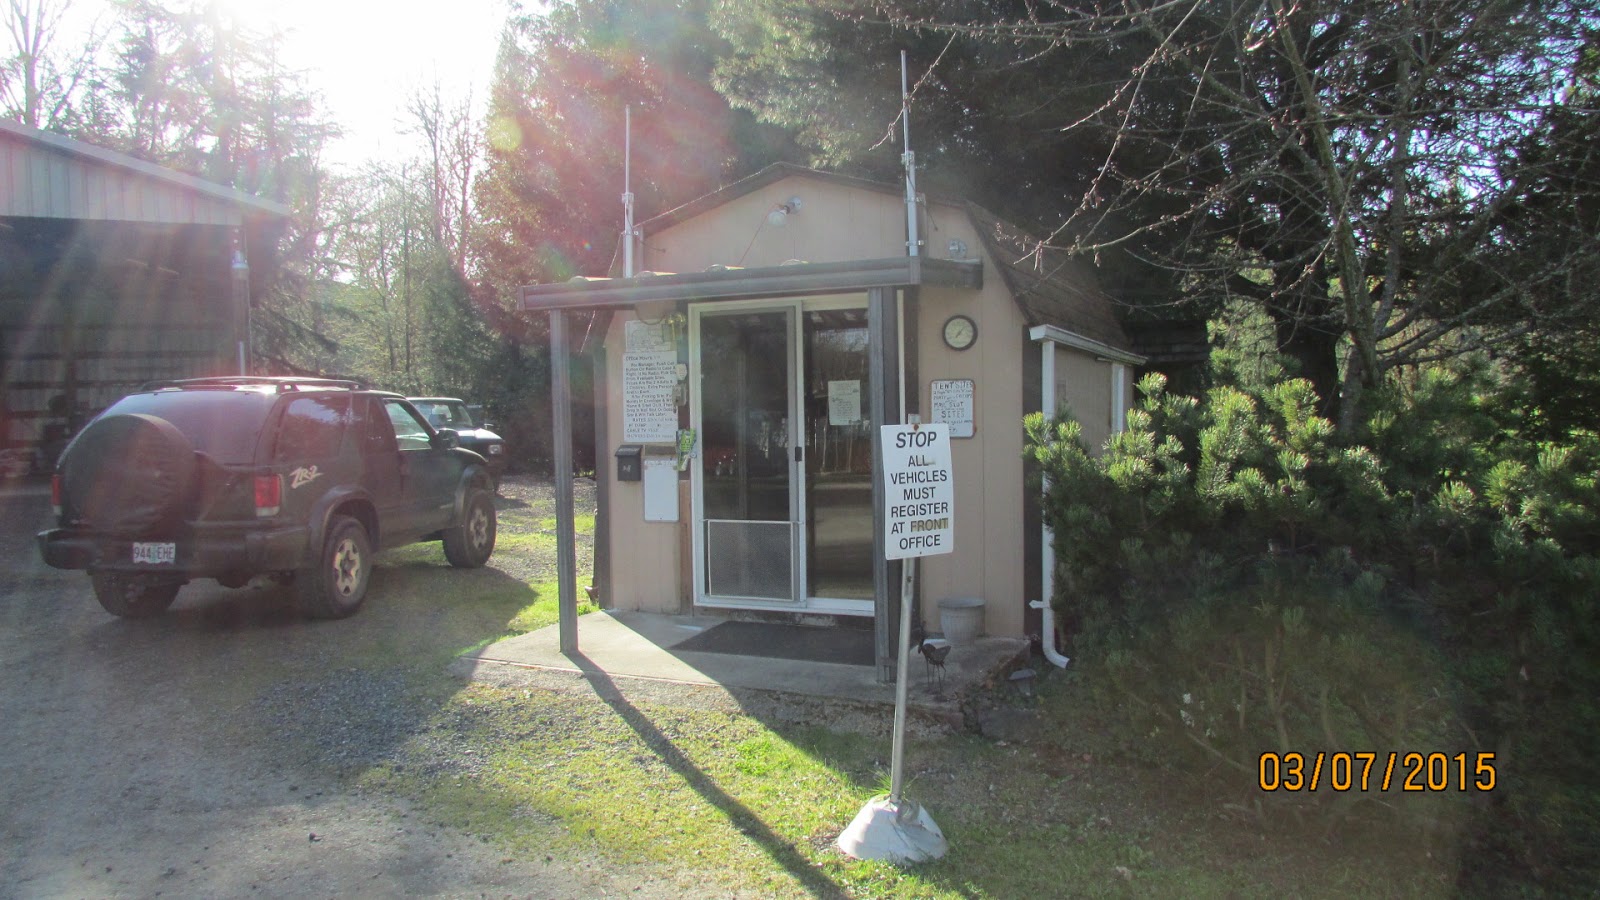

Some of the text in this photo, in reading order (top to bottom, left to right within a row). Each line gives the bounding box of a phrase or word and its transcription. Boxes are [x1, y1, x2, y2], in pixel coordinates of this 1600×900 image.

[896, 431, 937, 448] STOP
[908, 455, 929, 467] ALL
[890, 469, 947, 485] VEHICLES
[904, 486, 936, 501] MUST
[891, 502, 948, 518] REGISTER
[891, 518, 948, 534] AT FRONT
[899, 534, 941, 550] OFFICE
